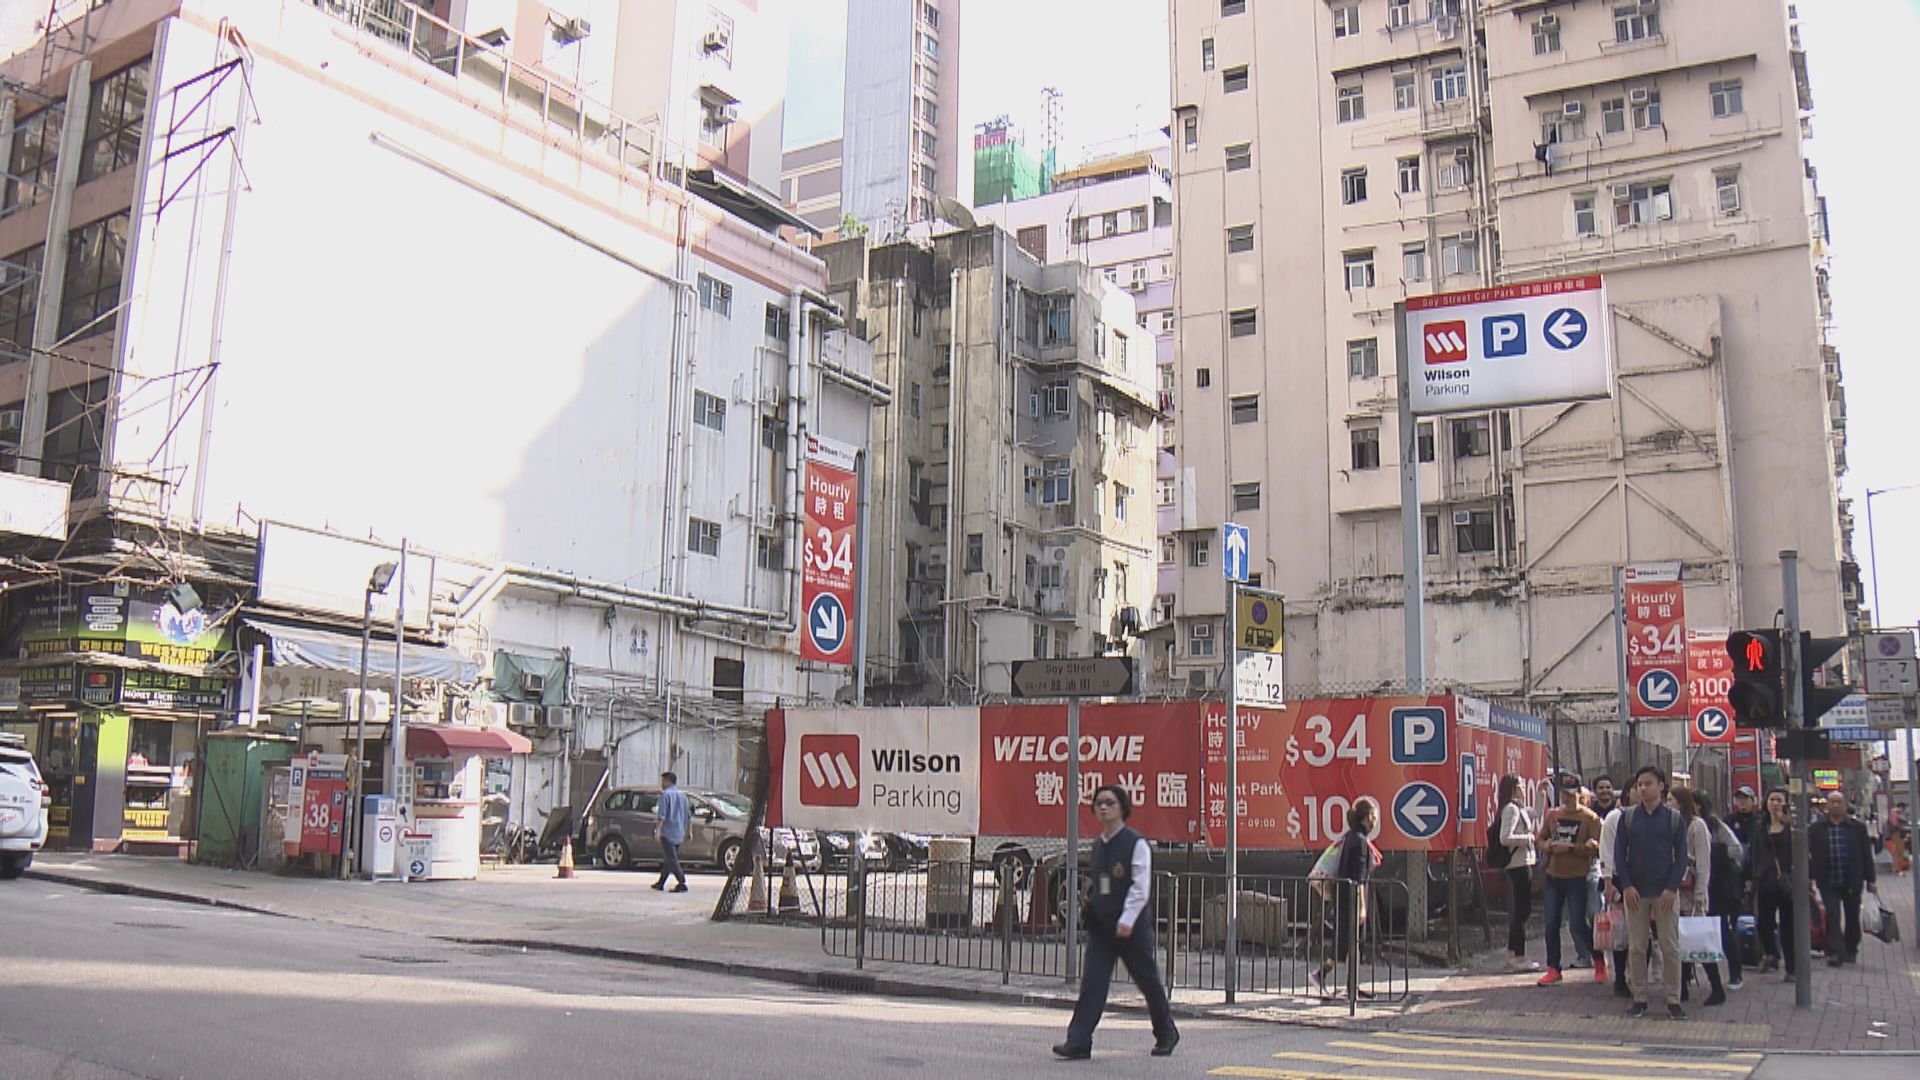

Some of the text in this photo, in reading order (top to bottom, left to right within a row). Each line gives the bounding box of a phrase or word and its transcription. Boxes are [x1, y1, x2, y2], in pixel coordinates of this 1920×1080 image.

[1443, 294, 1471, 305] Street
[1474, 291, 1490, 301] Car
[1494, 288, 1515, 298] Park
[1493, 320, 1519, 352] P
[1424, 368, 1470, 382] Wilson
[1425, 383, 1470, 397] Parking
[809, 476, 851, 503] Hourly
[804, 526, 853, 576] $34
[1631, 591, 1677, 605] Hourly
[1629, 623, 1684, 656] $34
[1066, 663, 1096, 673] Street
[1265, 656, 1273, 672] 7
[1898, 662, 1907, 673] 7
[1266, 683, 1280, 699] 12
[1689, 677, 1731, 697] $100
[1285, 713, 1371, 766] $34
[1403, 716, 1435, 756] P
[993, 735, 1145, 762] WELCOME
[872, 749, 961, 773] Wilson
[1251, 782, 1283, 795] Park
[1464, 764, 1474, 809] P
[872, 785, 962, 814] Parking
[304, 803, 330, 828] $38
[1248, 818, 1276, 828] 09:00
